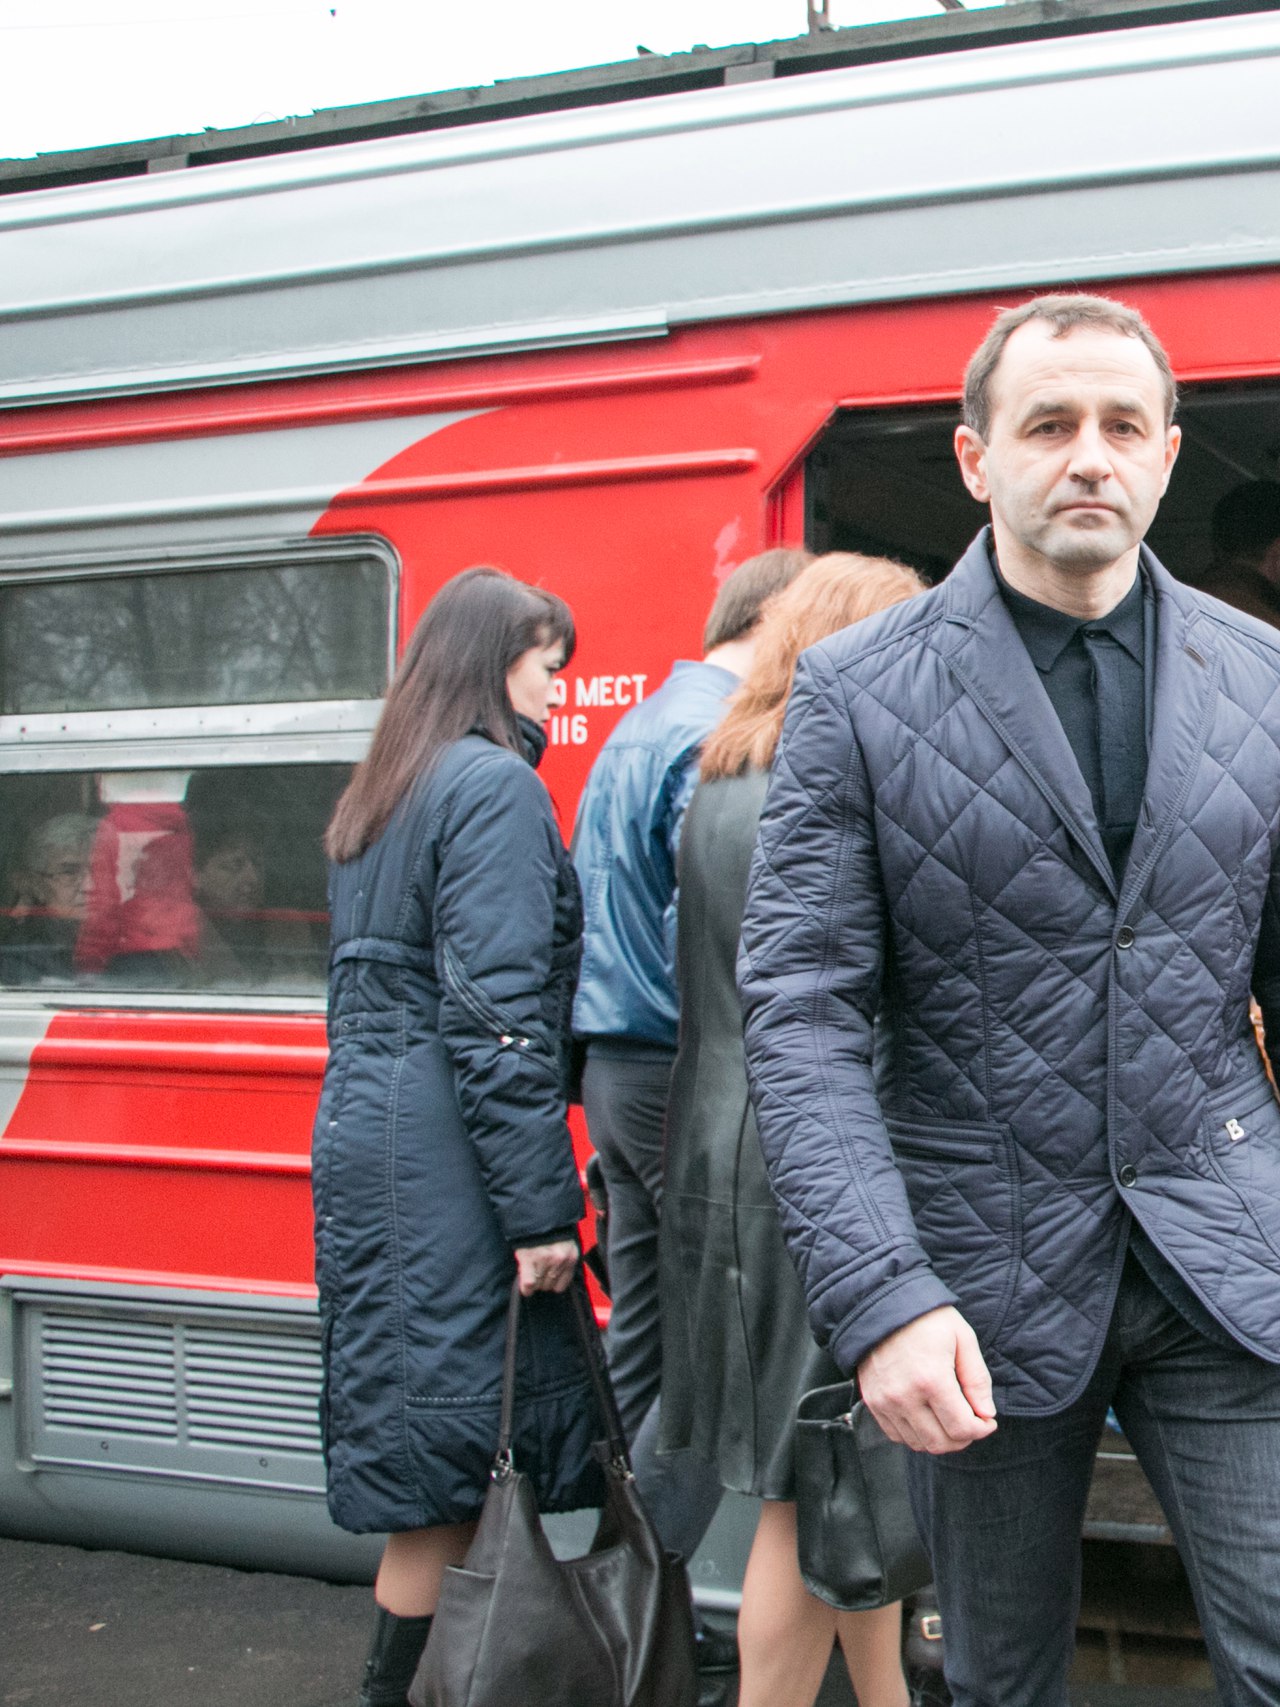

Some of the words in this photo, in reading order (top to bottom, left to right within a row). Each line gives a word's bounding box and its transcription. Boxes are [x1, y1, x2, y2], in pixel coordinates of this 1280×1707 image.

[575, 674, 648, 707] МЕСТ
[551, 714, 588, 745] 116
[1225, 1118, 1245, 1141] B
